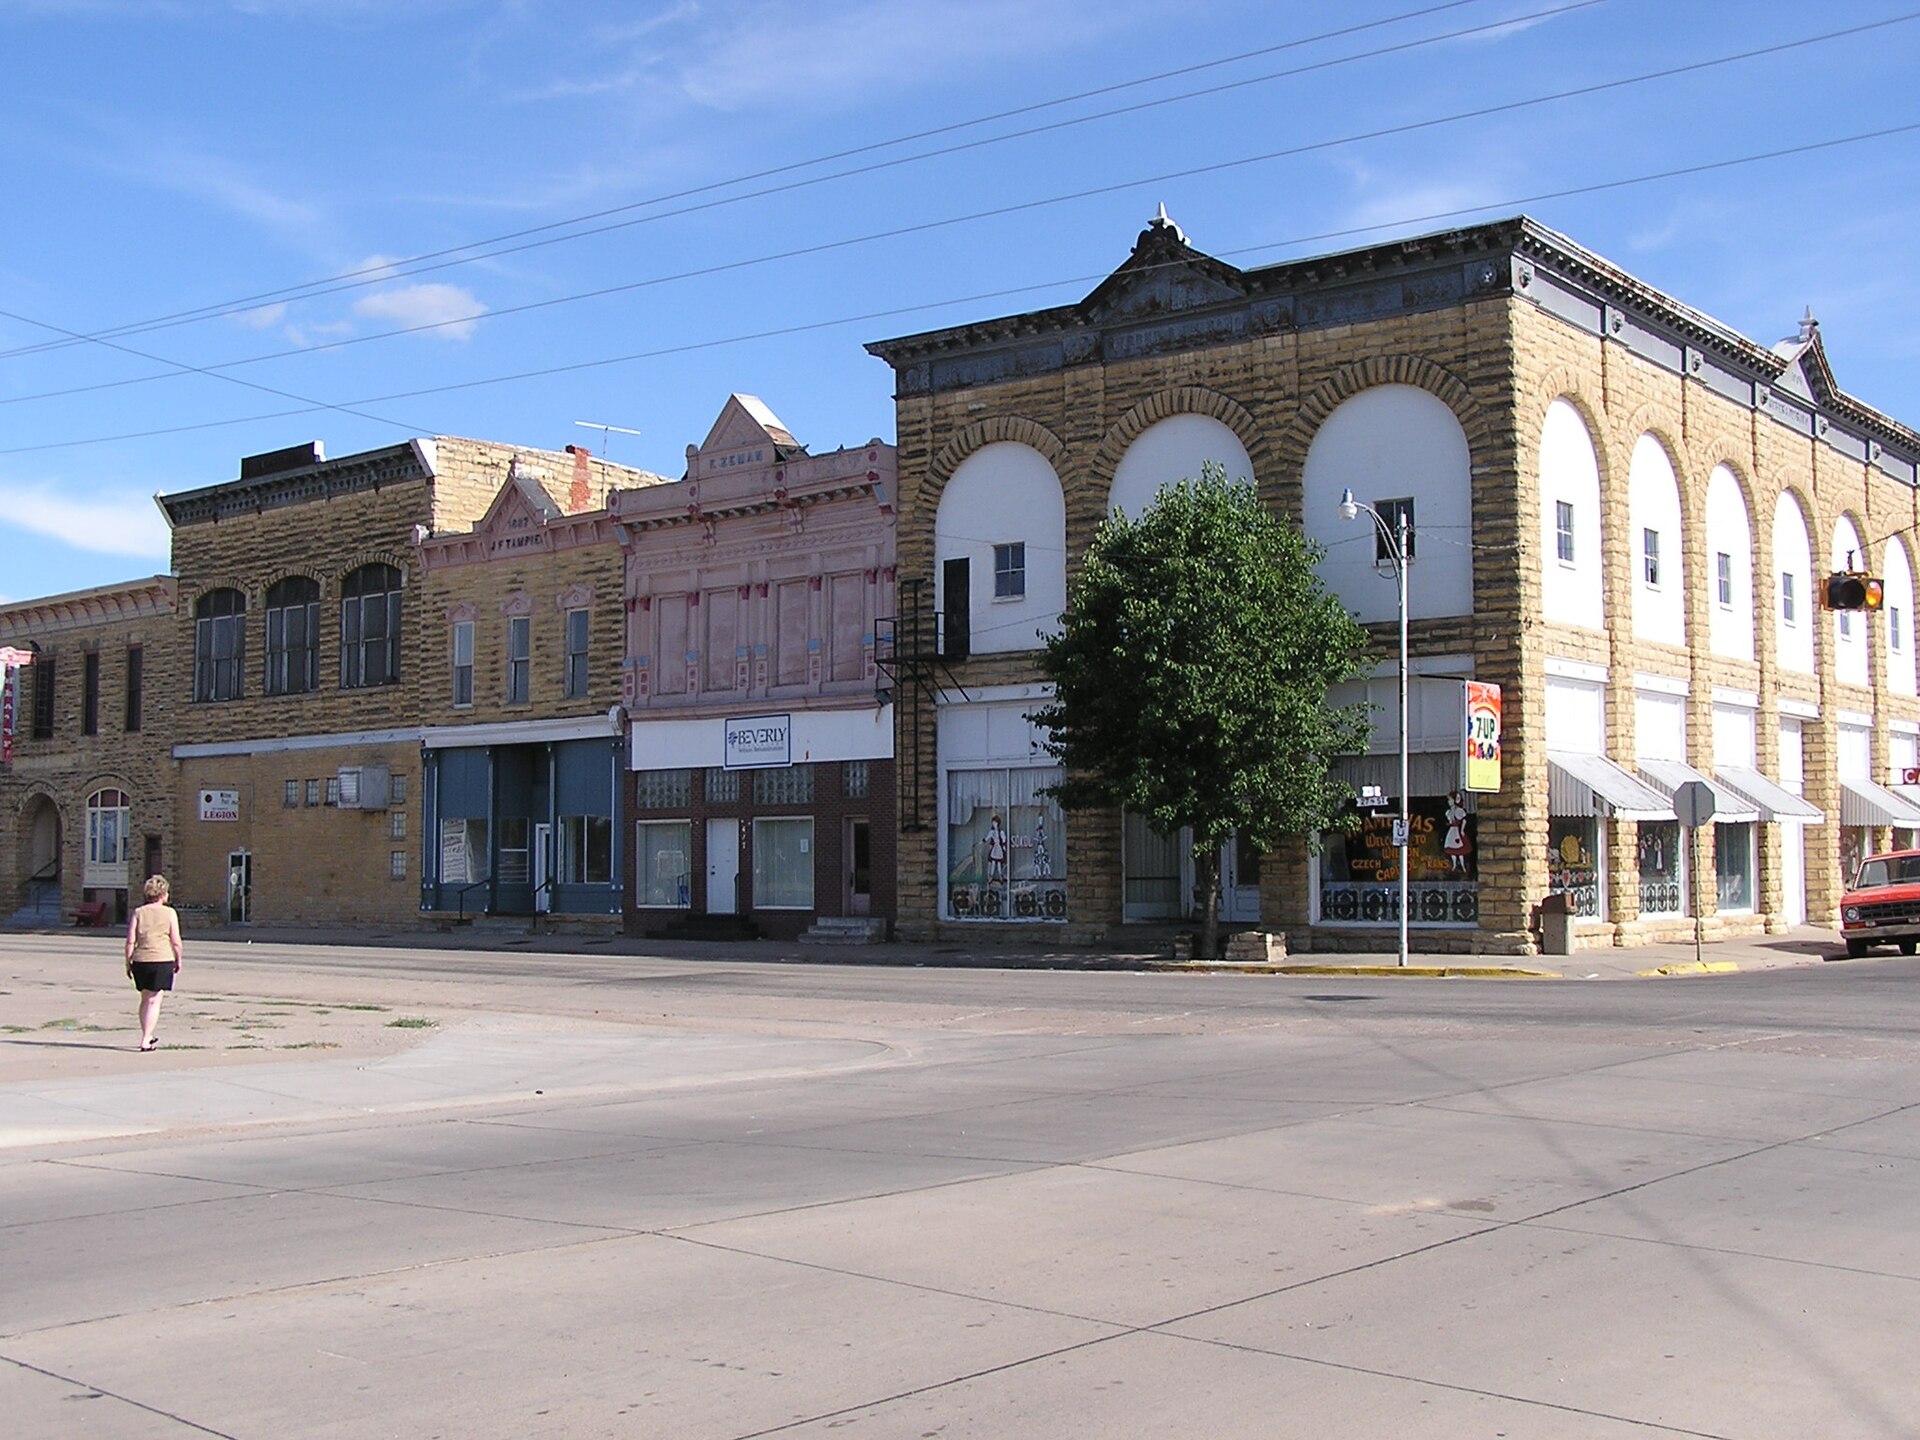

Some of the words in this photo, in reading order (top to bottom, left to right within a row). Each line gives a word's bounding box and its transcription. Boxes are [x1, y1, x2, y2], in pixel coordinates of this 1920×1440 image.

[738, 728, 787, 745] BEVERLY
[204, 811, 238, 819] LEGION
[1397, 828, 1405, 836] U
[1351, 859, 1382, 870] CZECH
